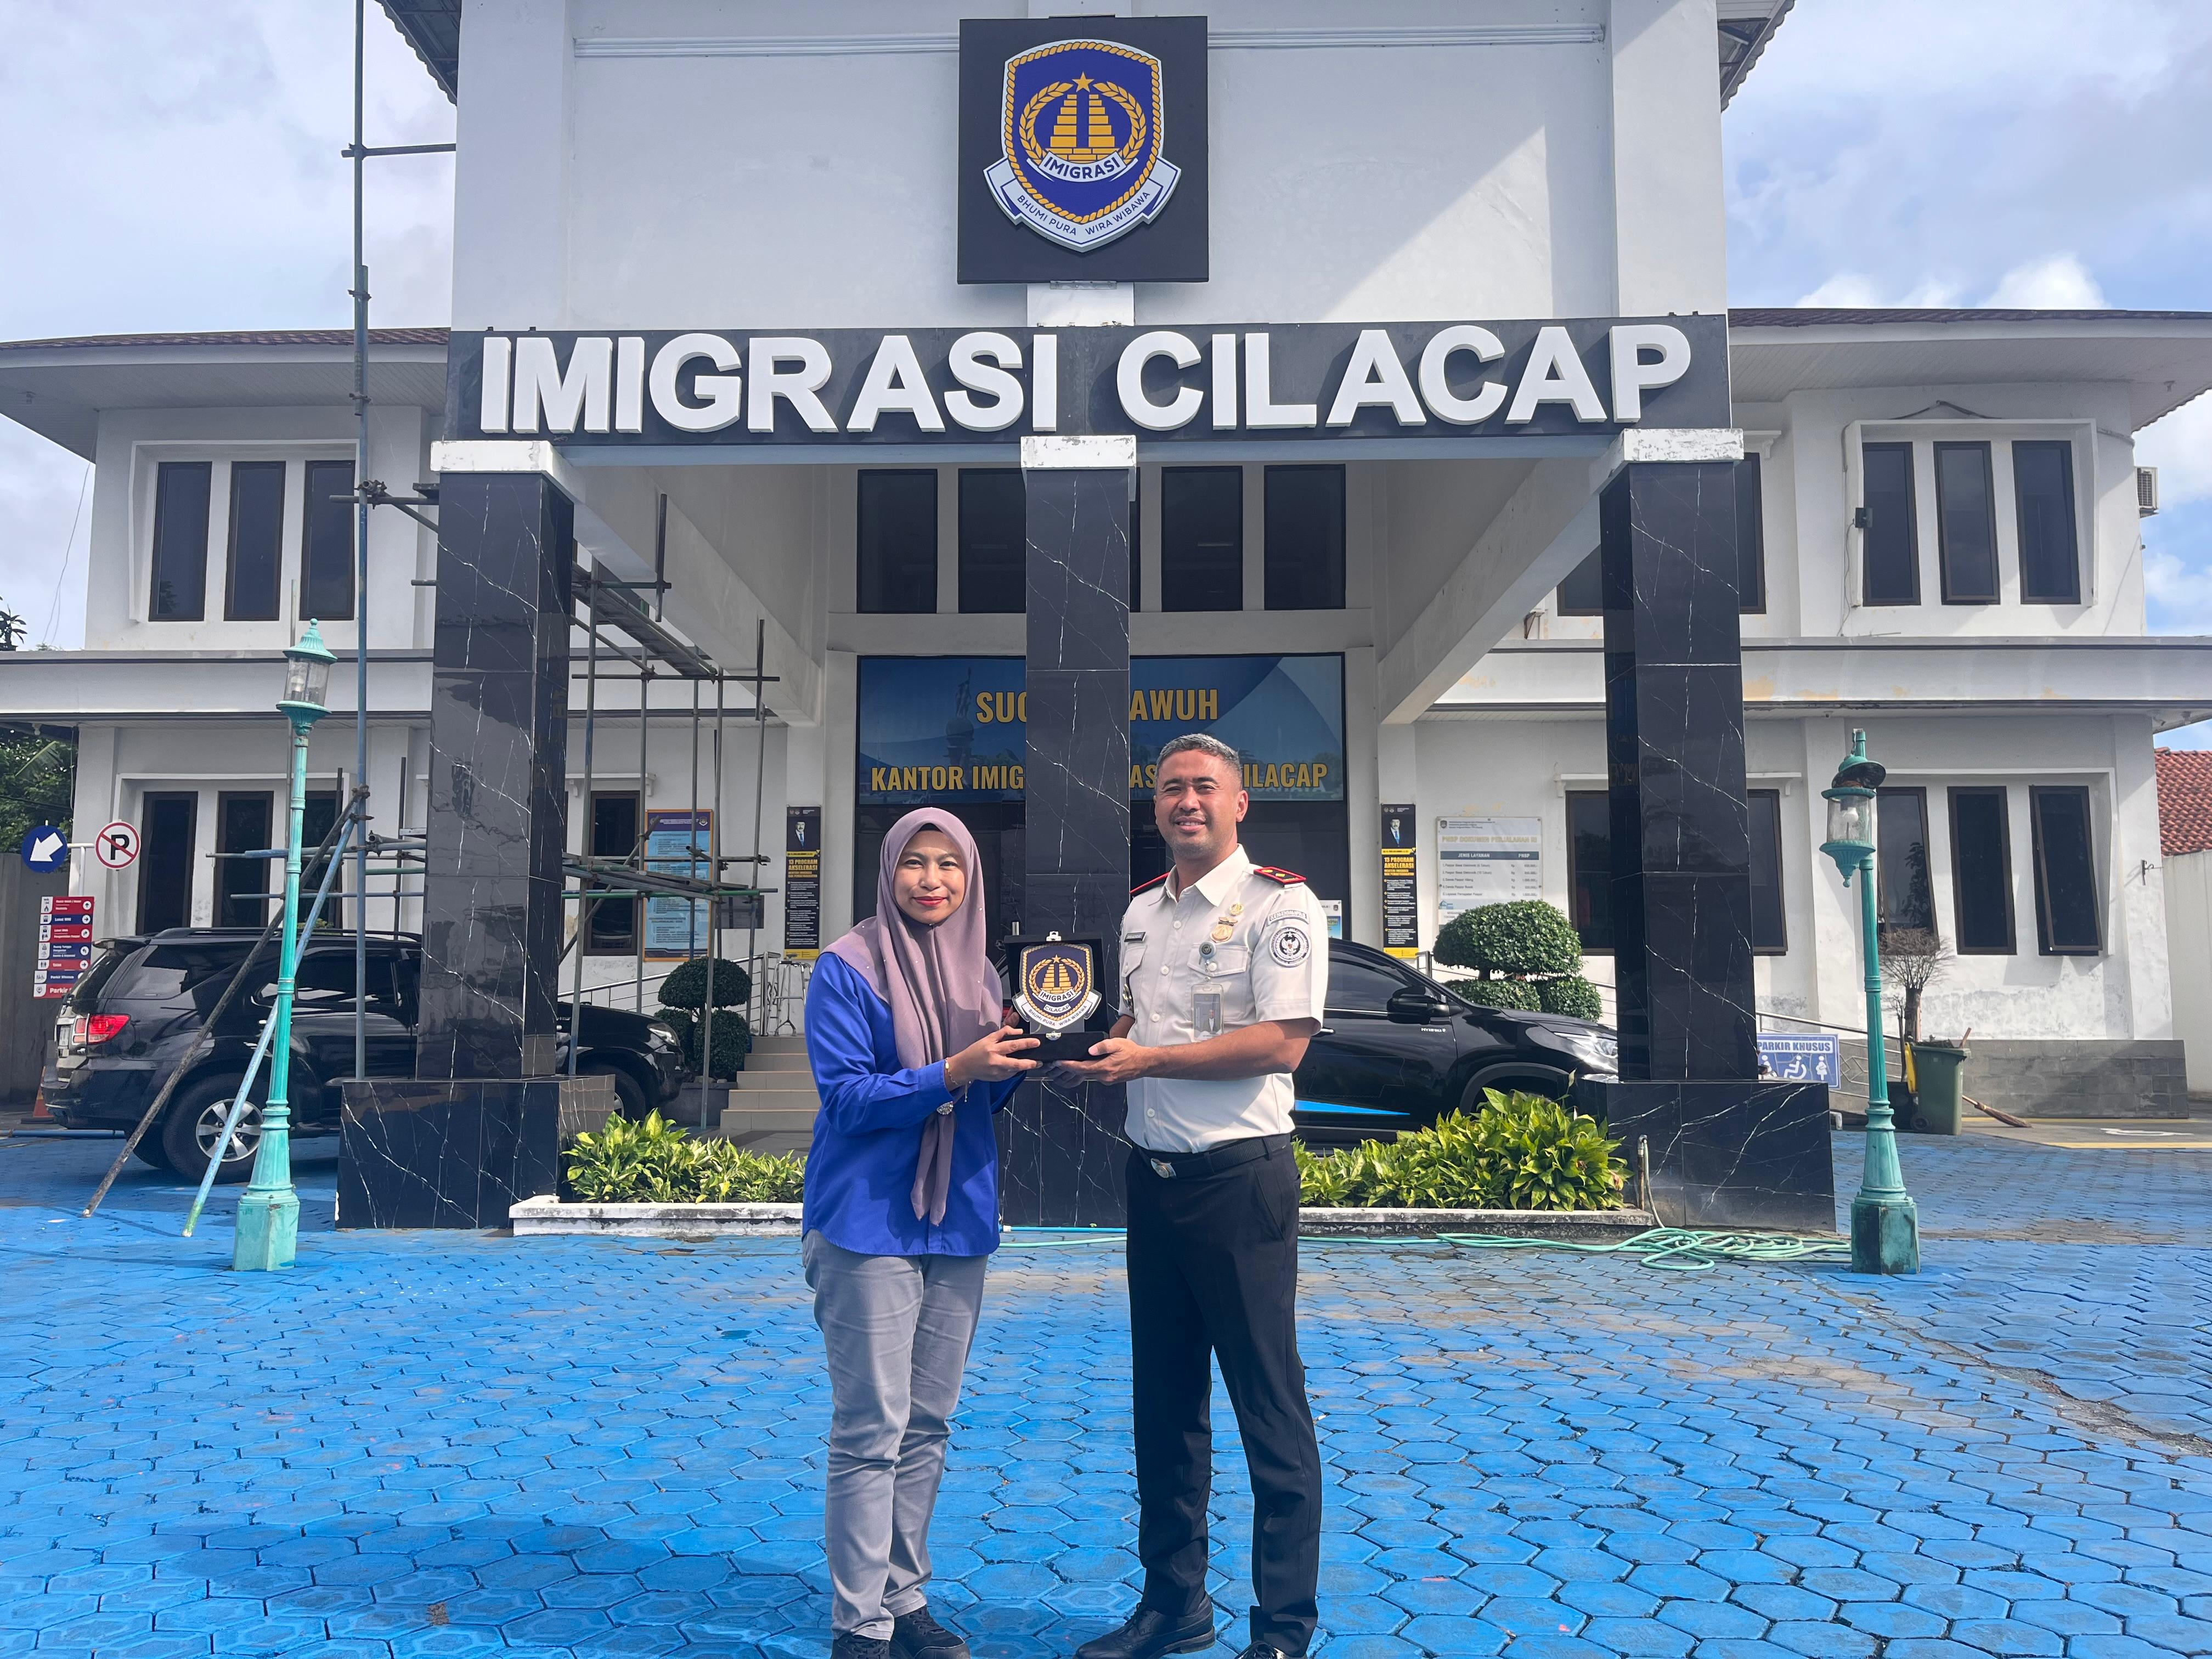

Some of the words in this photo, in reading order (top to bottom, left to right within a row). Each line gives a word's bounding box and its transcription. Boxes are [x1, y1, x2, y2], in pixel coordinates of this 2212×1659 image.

[1044, 156, 1120, 179] IMIGRASI
[1017, 194, 1048, 222] BHUMI
[1049, 219, 1076, 235] PURA
[1085, 221, 1113, 235] WIRA
[1113, 192, 1150, 222] WIBAWA
[480, 331, 1057, 434] IMIGRASI
[1116, 324, 1691, 432] CILACAP
[871, 766, 964, 791] KANTOR
[110, 834, 129, 860] P
[1040, 991, 1074, 1001] IMIGRASI
[1071, 1005, 1087, 1020] WIBAWA
[1757, 1042, 1791, 1050] PARKIR
[1793, 1042, 1831, 1051] KHUSUS
